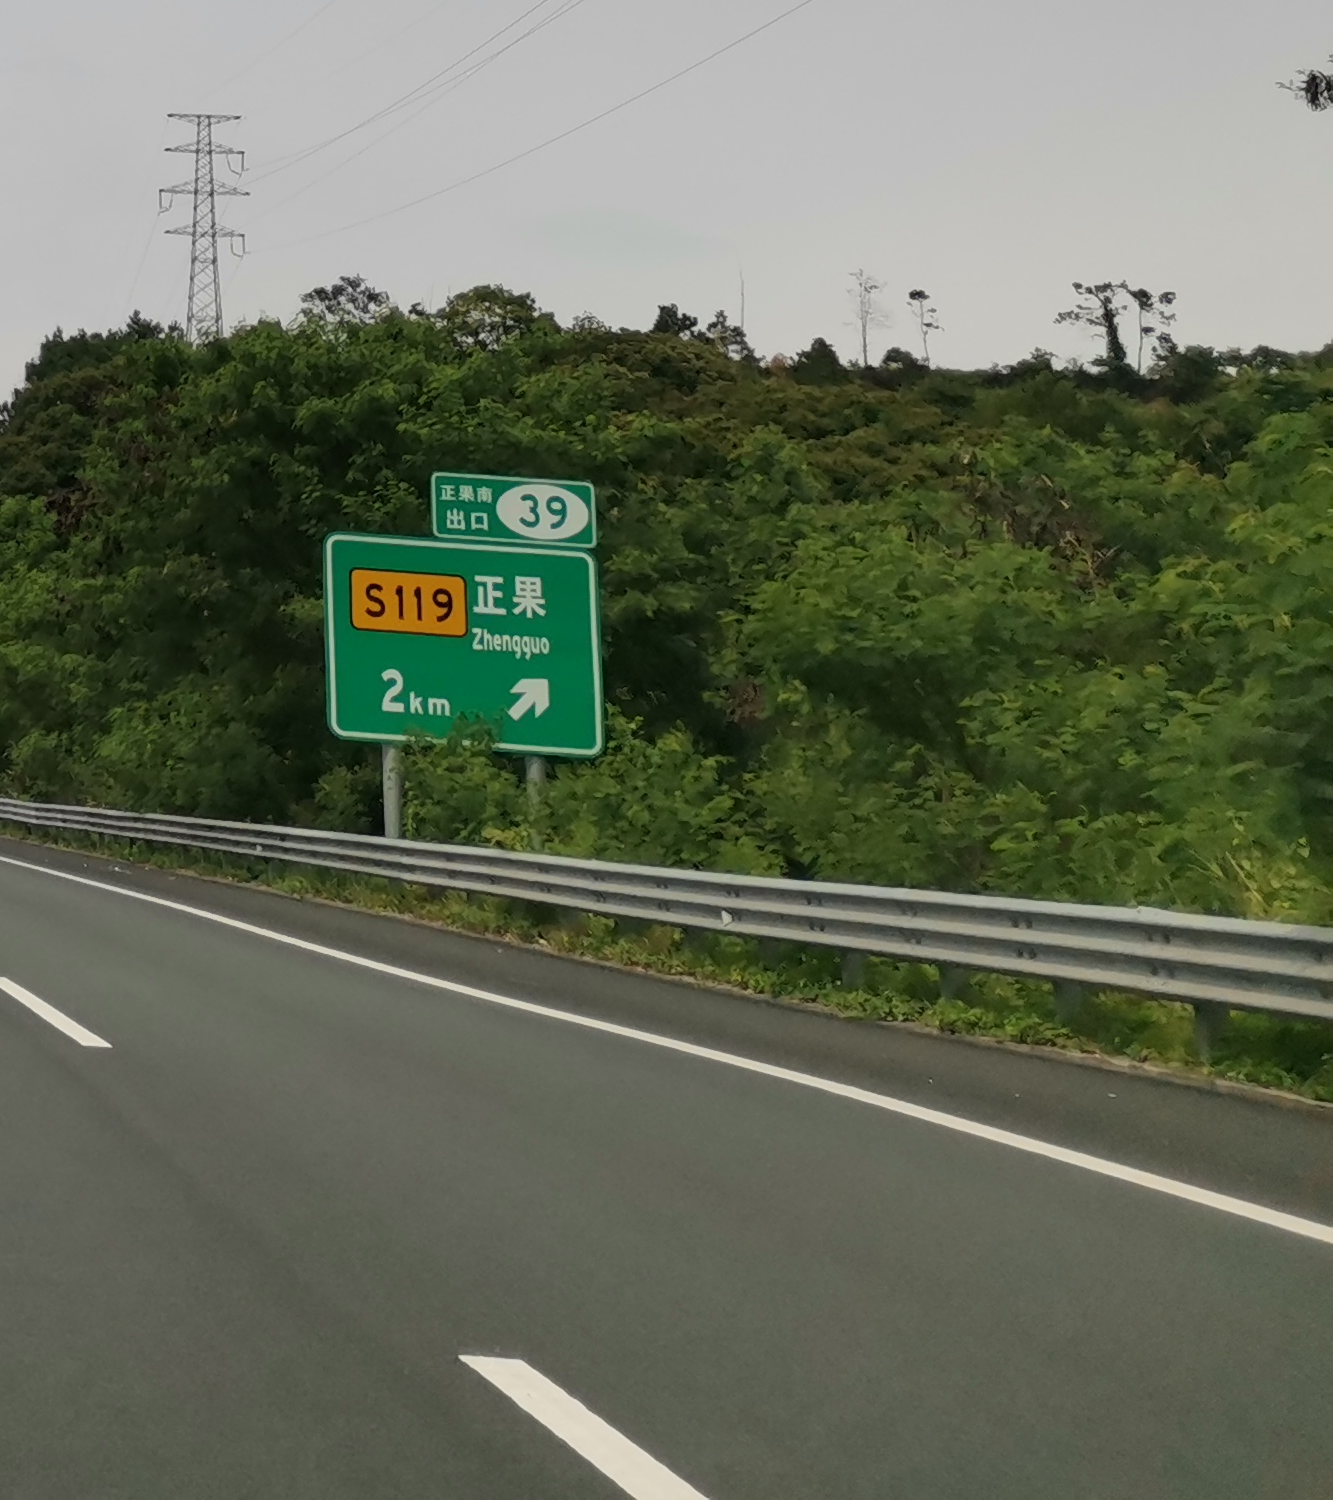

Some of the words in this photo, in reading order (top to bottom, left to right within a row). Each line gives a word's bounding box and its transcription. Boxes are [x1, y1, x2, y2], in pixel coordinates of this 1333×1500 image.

[445, 507, 489, 531] 出口
[518, 493, 568, 530] 39
[364, 583, 454, 622] S119
[472, 574, 547, 619] 正果
[471, 627, 550, 660] Zhengguo
